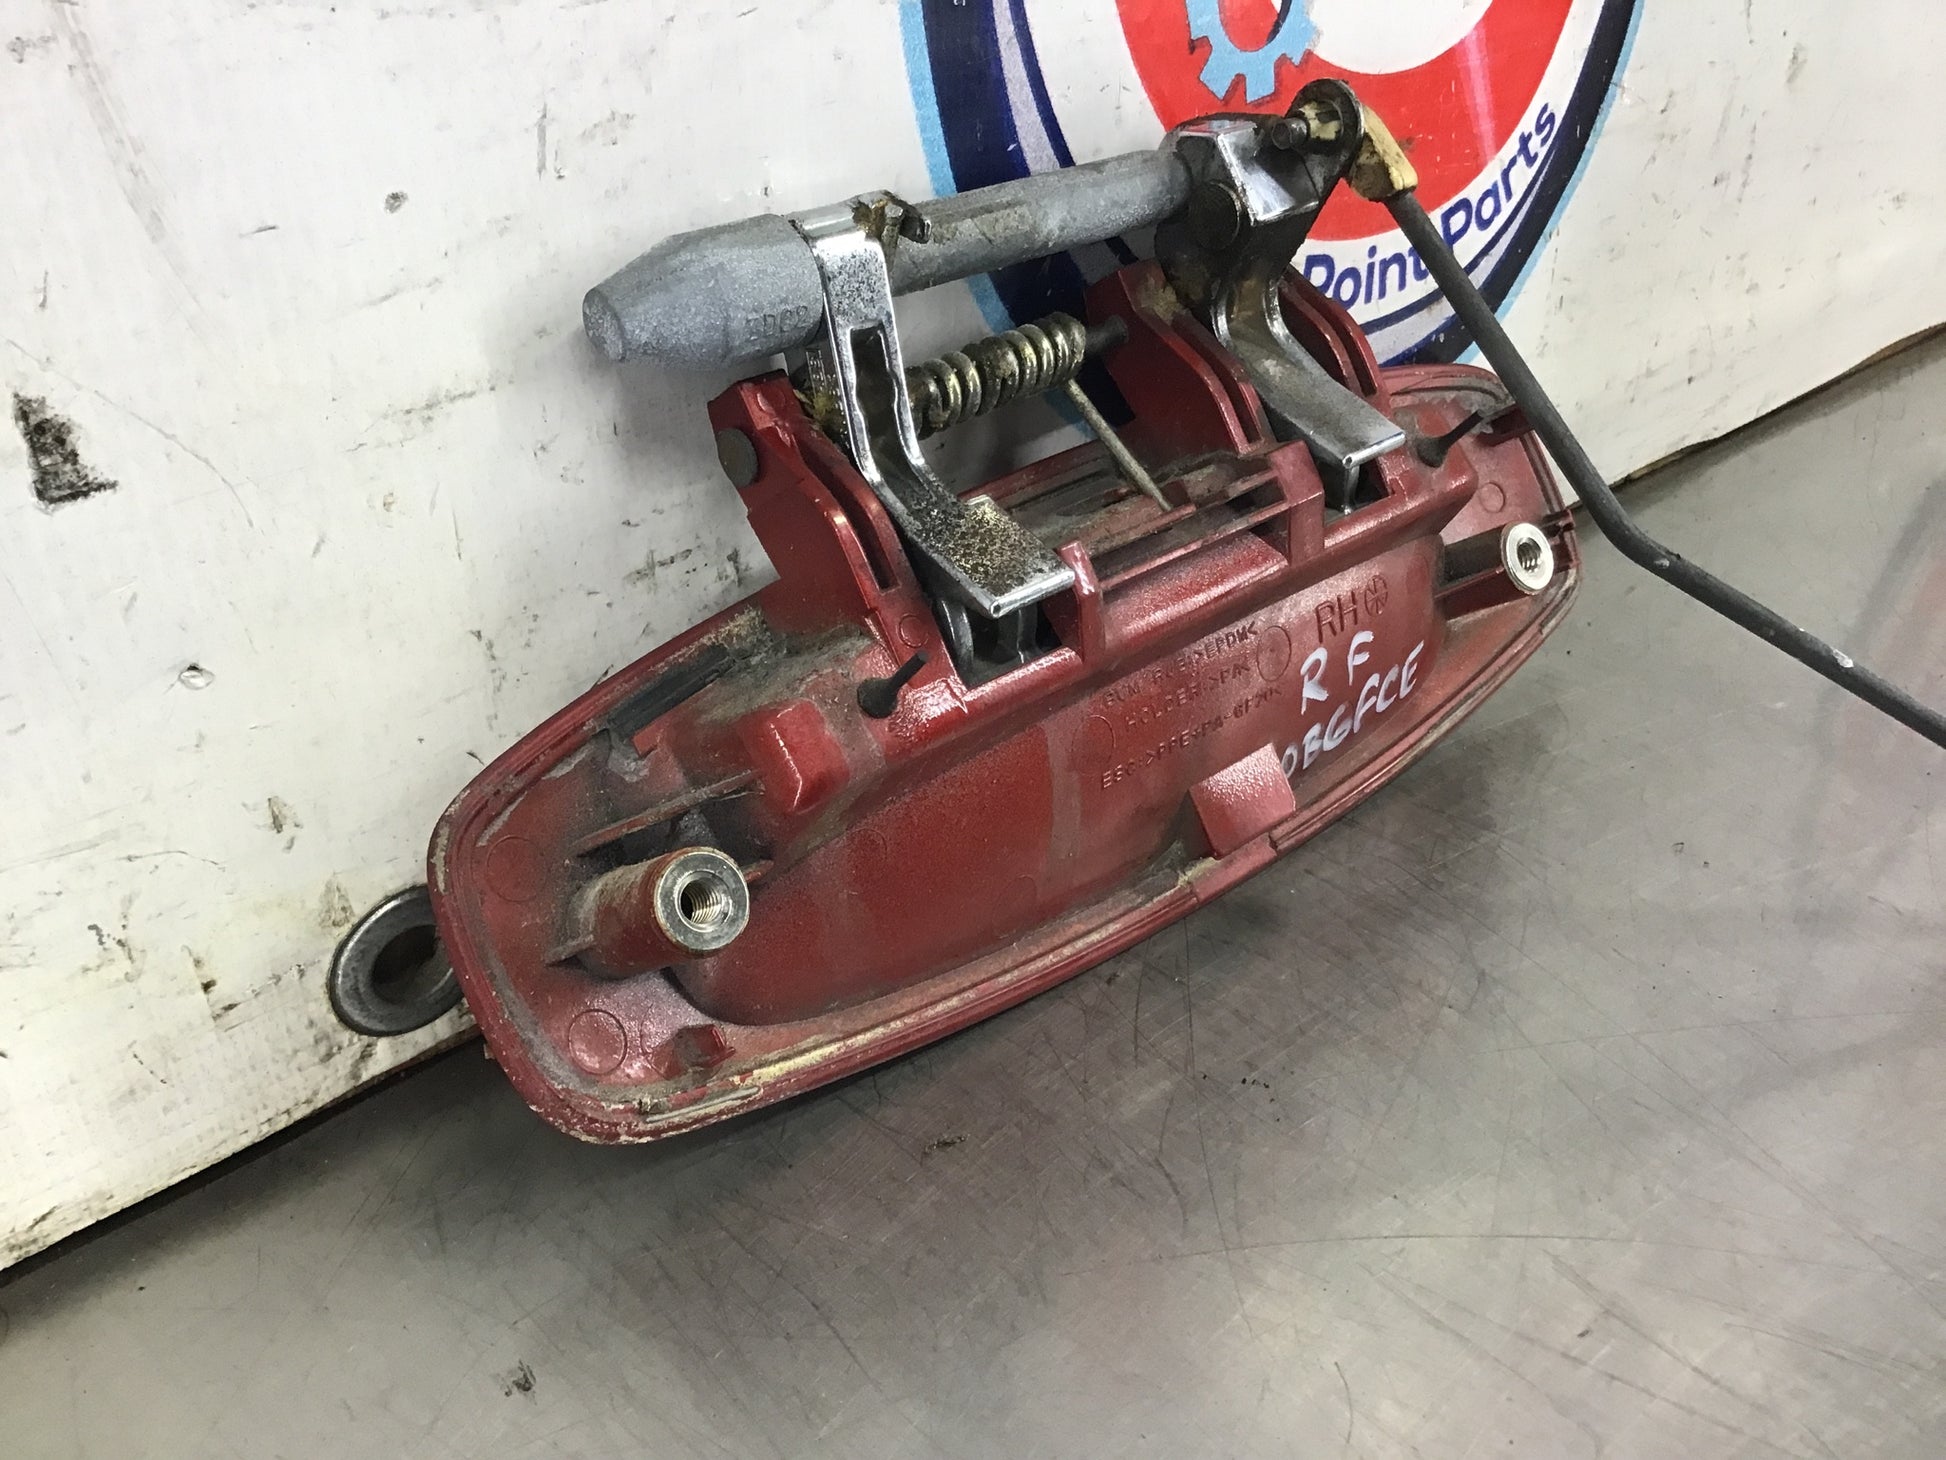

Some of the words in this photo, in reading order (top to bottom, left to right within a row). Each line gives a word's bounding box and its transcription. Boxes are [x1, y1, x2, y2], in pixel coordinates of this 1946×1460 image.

[1304, 245, 1430, 311] Point
[1441, 102, 1557, 250] Parts
[1315, 590, 1359, 644] RH
[1299, 646, 1329, 716] R
[1346, 630, 1375, 687] F
